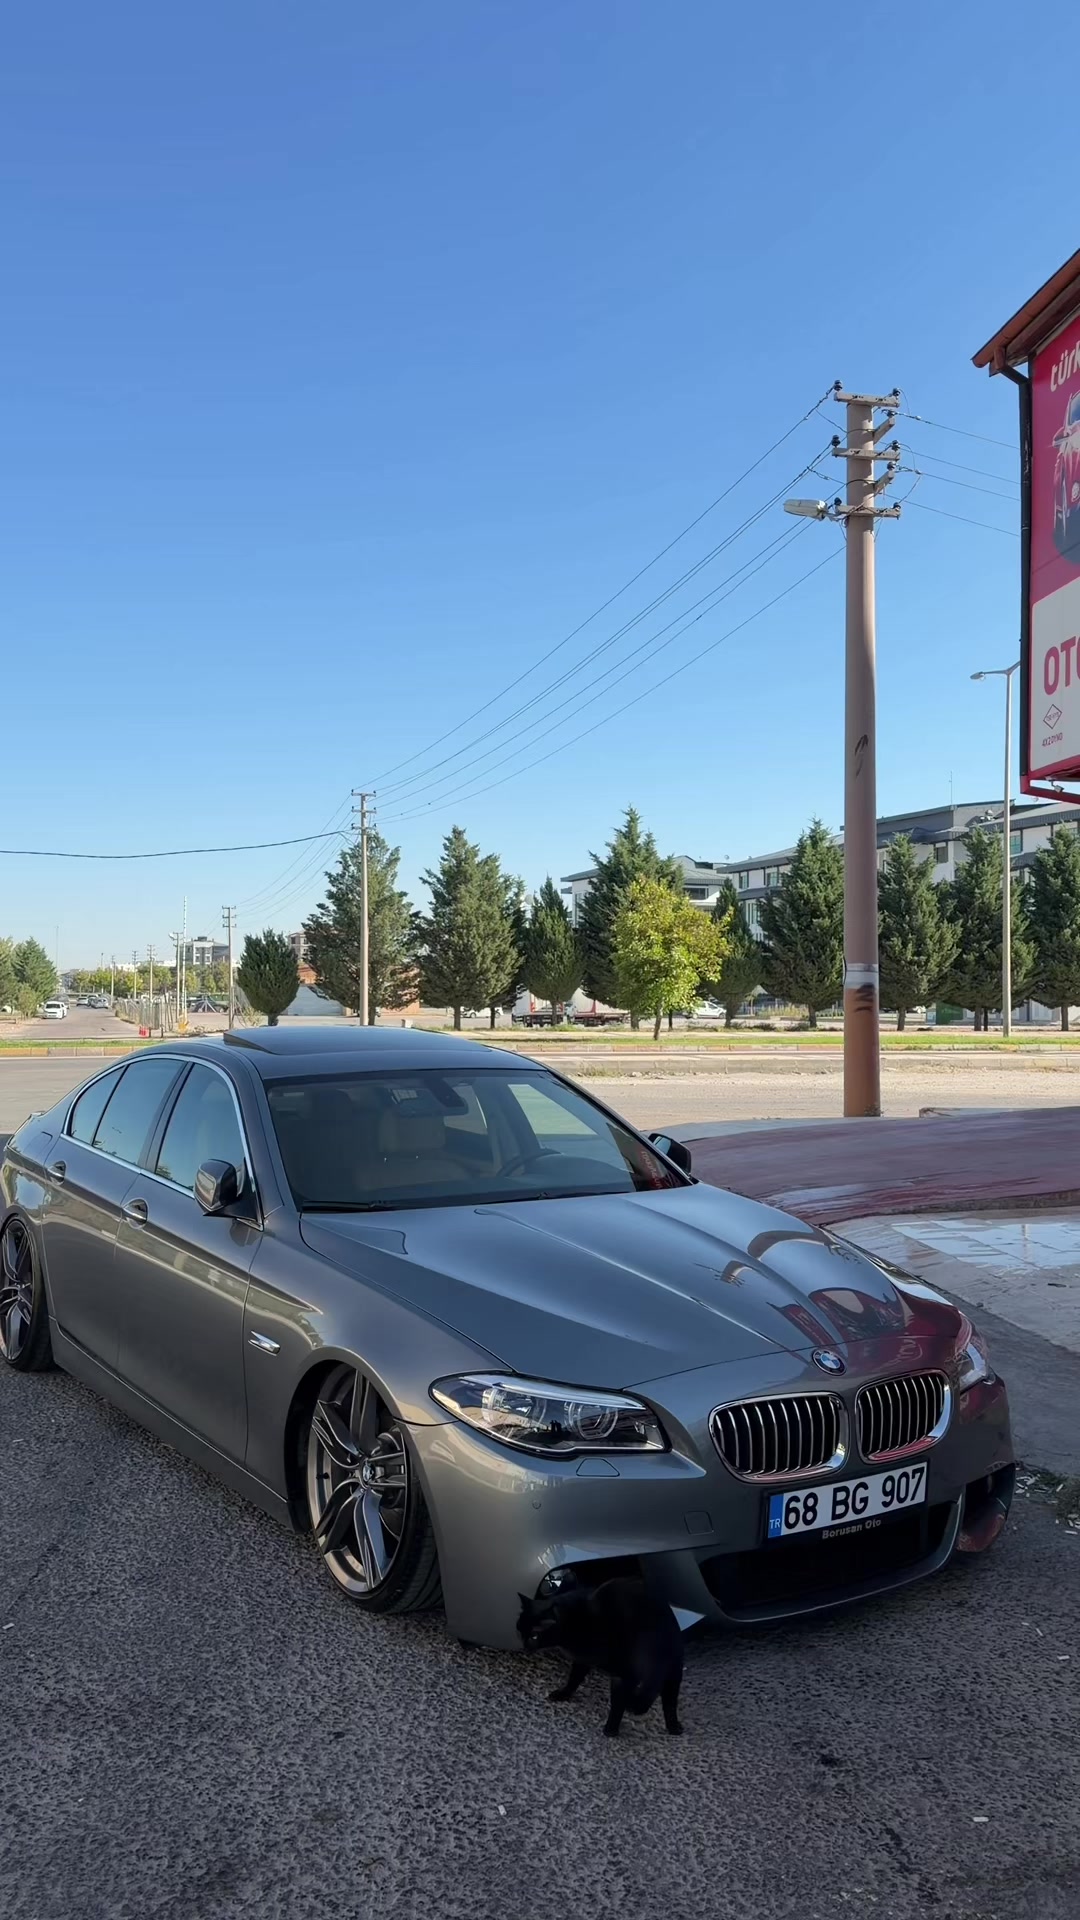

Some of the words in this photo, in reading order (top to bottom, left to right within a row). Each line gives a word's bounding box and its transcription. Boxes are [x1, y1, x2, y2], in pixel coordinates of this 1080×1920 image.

[1044, 635, 1080, 696] OT
[769, 1518, 781, 1530] TR
[784, 1491, 819, 1530] 68
[831, 1481, 869, 1521] BG
[881, 1466, 925, 1508] 907
[822, 1524, 863, 1540] Borusan
[865, 1518, 882, 1529] Oto
